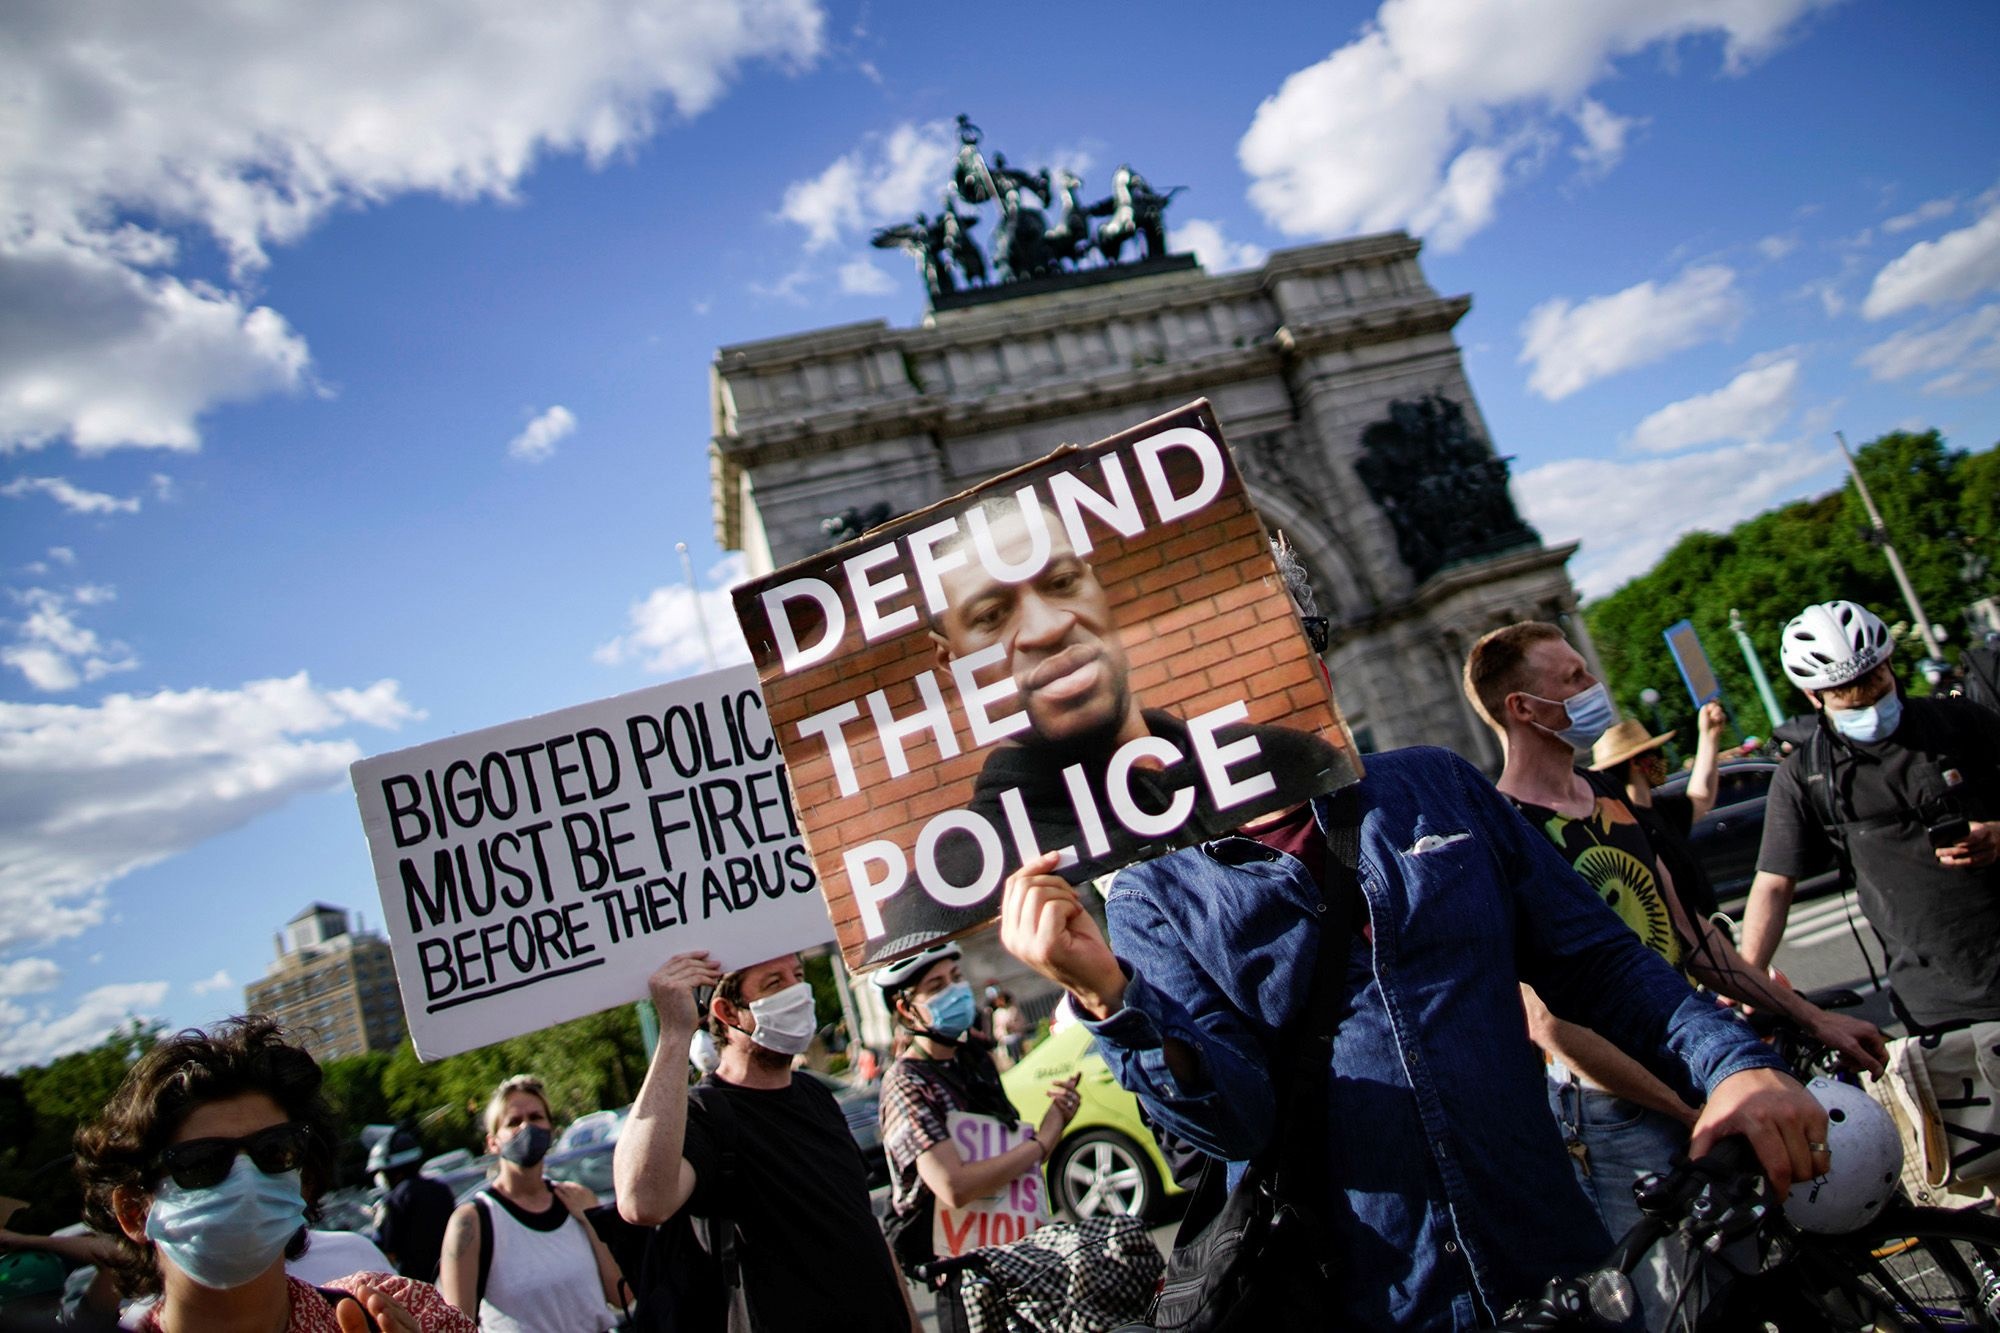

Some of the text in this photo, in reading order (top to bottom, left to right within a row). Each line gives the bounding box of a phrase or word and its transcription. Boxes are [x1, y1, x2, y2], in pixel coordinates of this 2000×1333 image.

[760, 427, 1224, 673] DEFUND
[382, 689, 783, 848] BIGOTED POLIC
[798, 643, 1032, 799] THE
[399, 820, 553, 933] MUST
[562, 803, 646, 890] BE
[843, 701, 1277, 940] POLICE
[417, 902, 596, 1000] BEFORE
[592, 871, 689, 944] THEY
[941, 1209, 1043, 1257] VIO
[1010, 1177, 1037, 1213] IS
